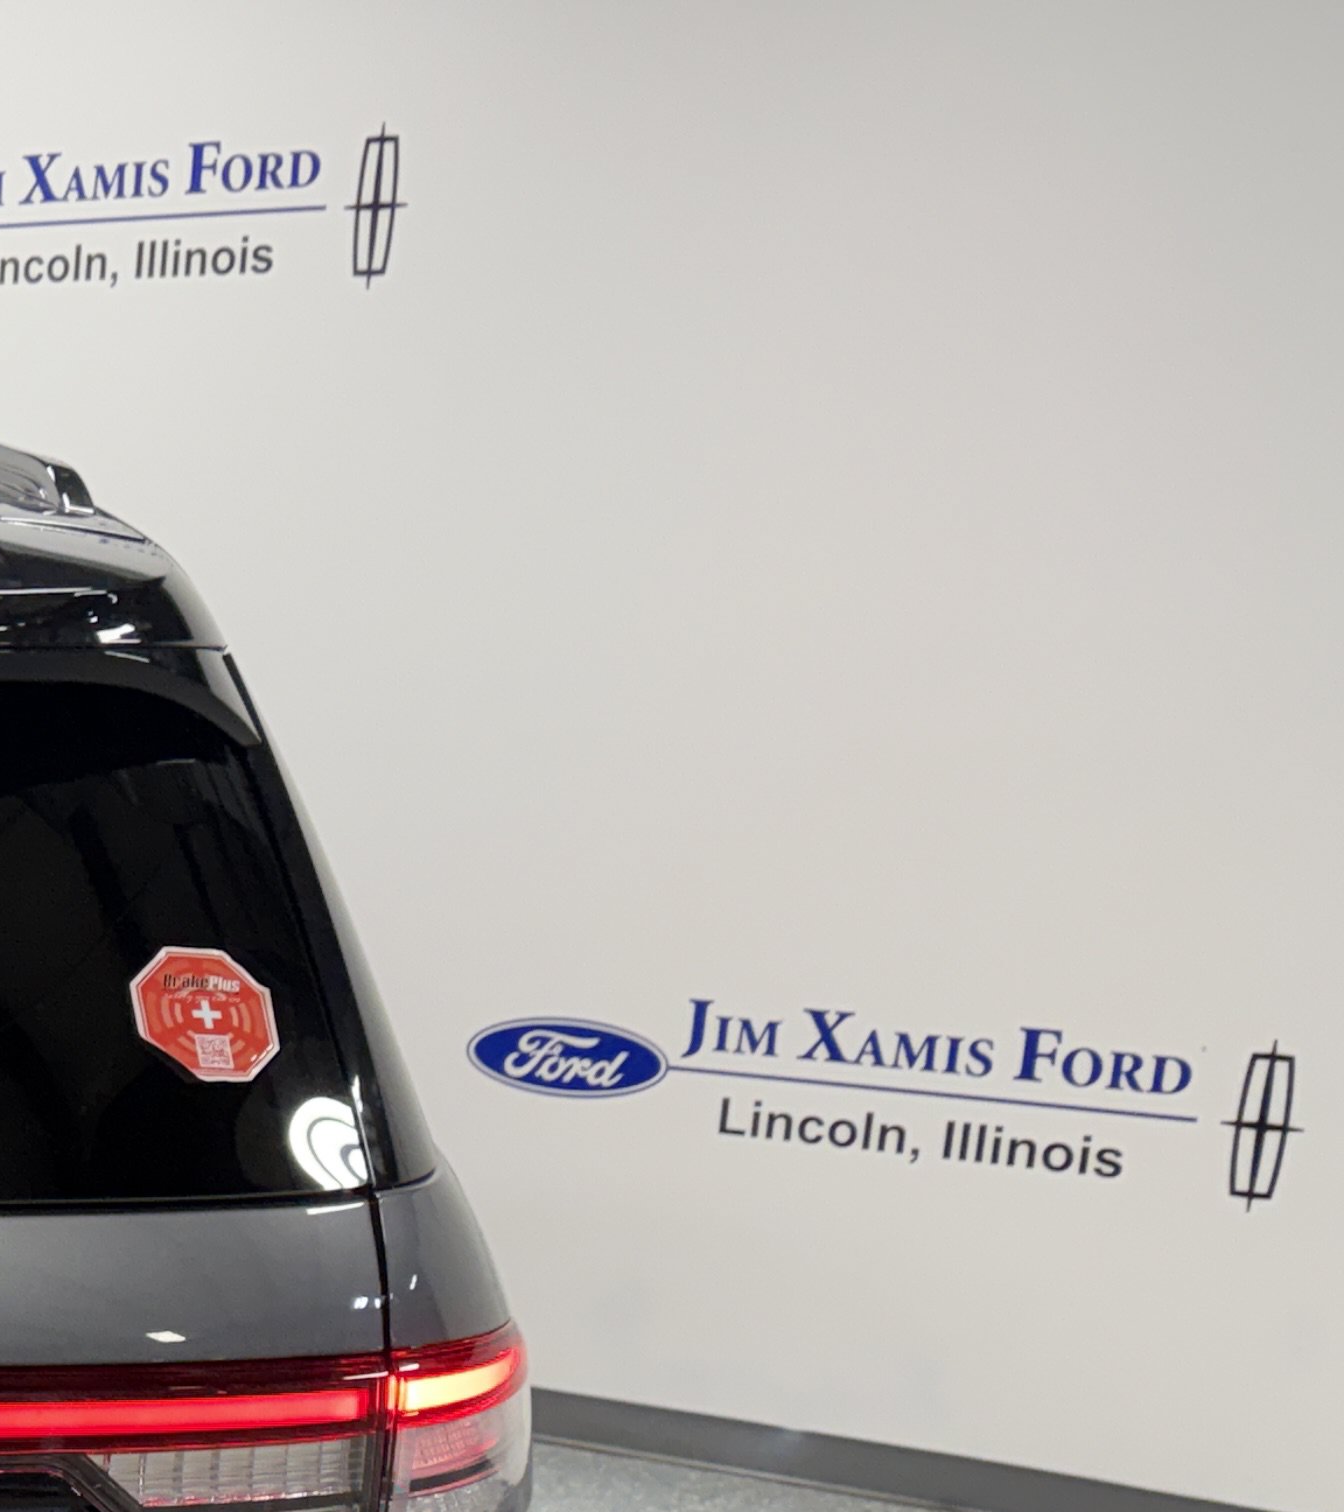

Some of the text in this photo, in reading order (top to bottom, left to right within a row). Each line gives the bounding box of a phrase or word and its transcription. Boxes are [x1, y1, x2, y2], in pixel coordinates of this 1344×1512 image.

[136, 236, 272, 278] Illinois
[503, 1028, 630, 1088] Ford
[719, 1098, 1122, 1177] Lincoln, Illinois
